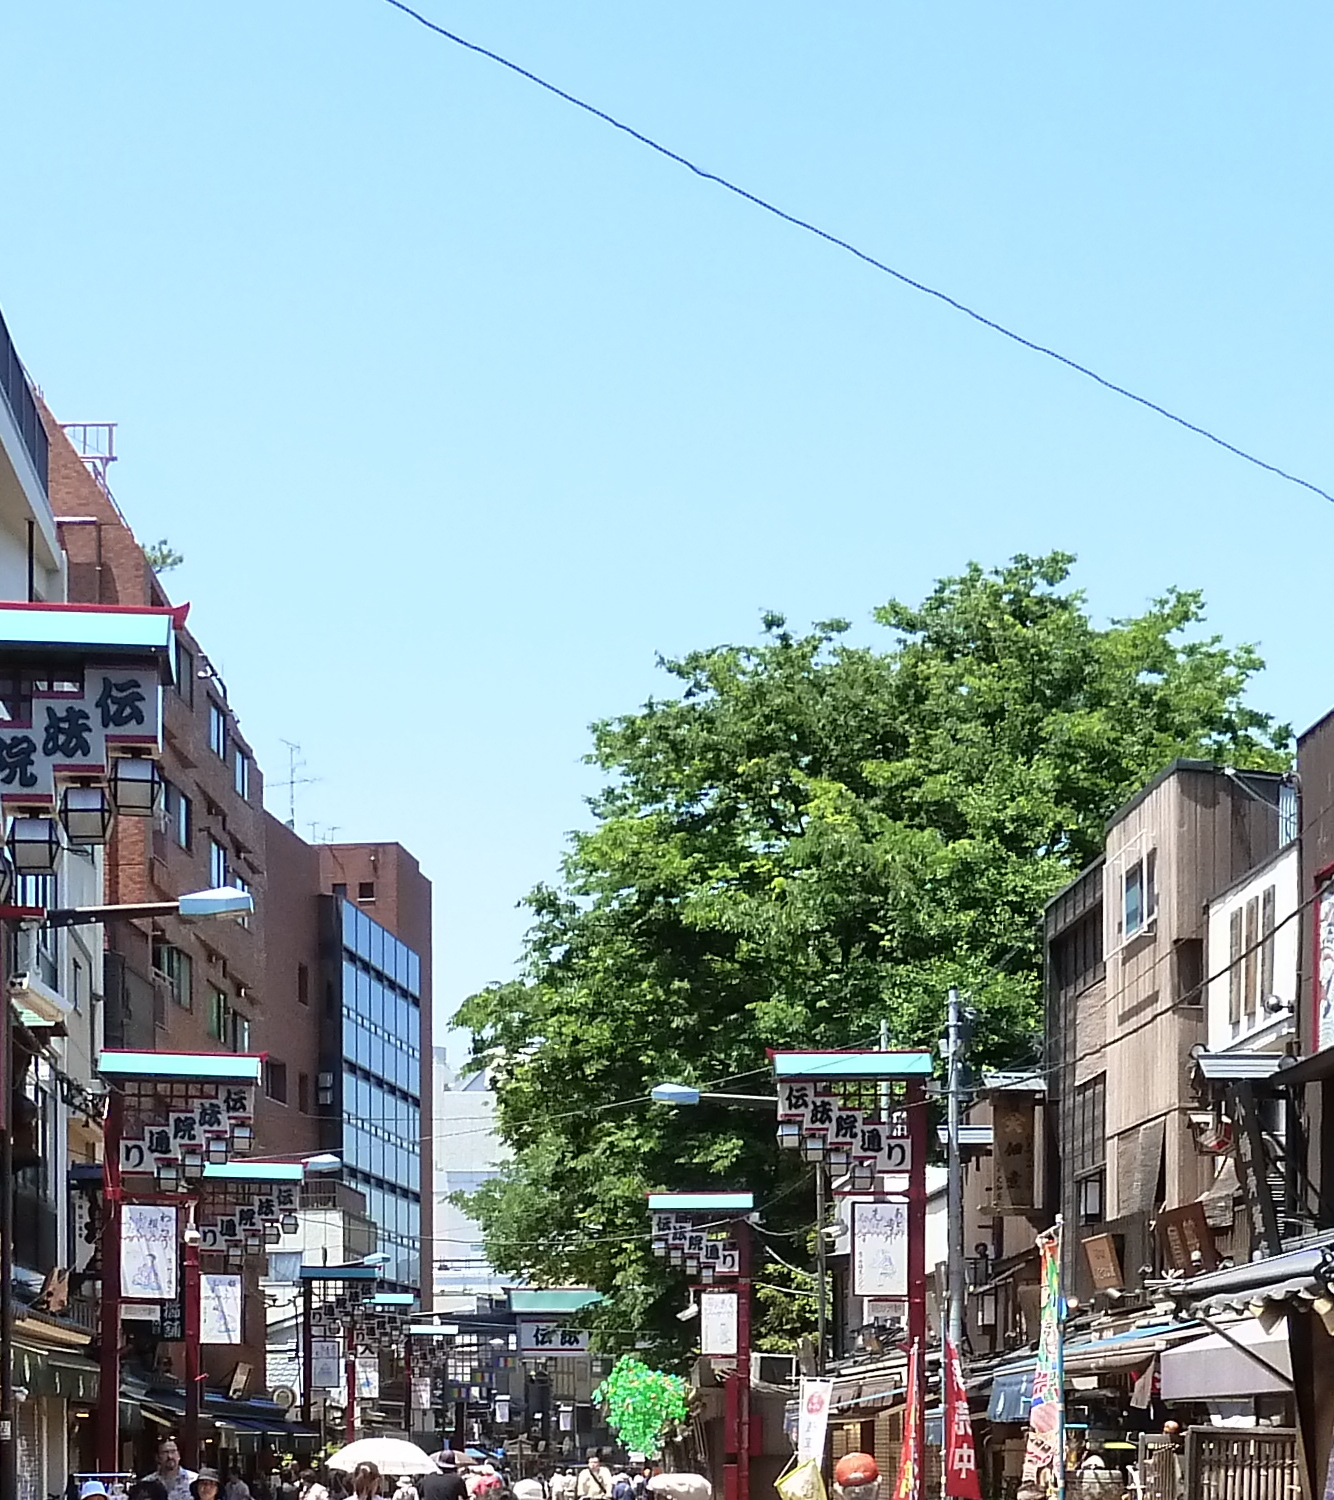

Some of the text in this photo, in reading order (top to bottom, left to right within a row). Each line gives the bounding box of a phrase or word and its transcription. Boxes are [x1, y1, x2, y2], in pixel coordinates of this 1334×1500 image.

[124, 1087, 247, 1169] 伝法院通り
[785, 1085, 907, 1167] 伝法院通り
